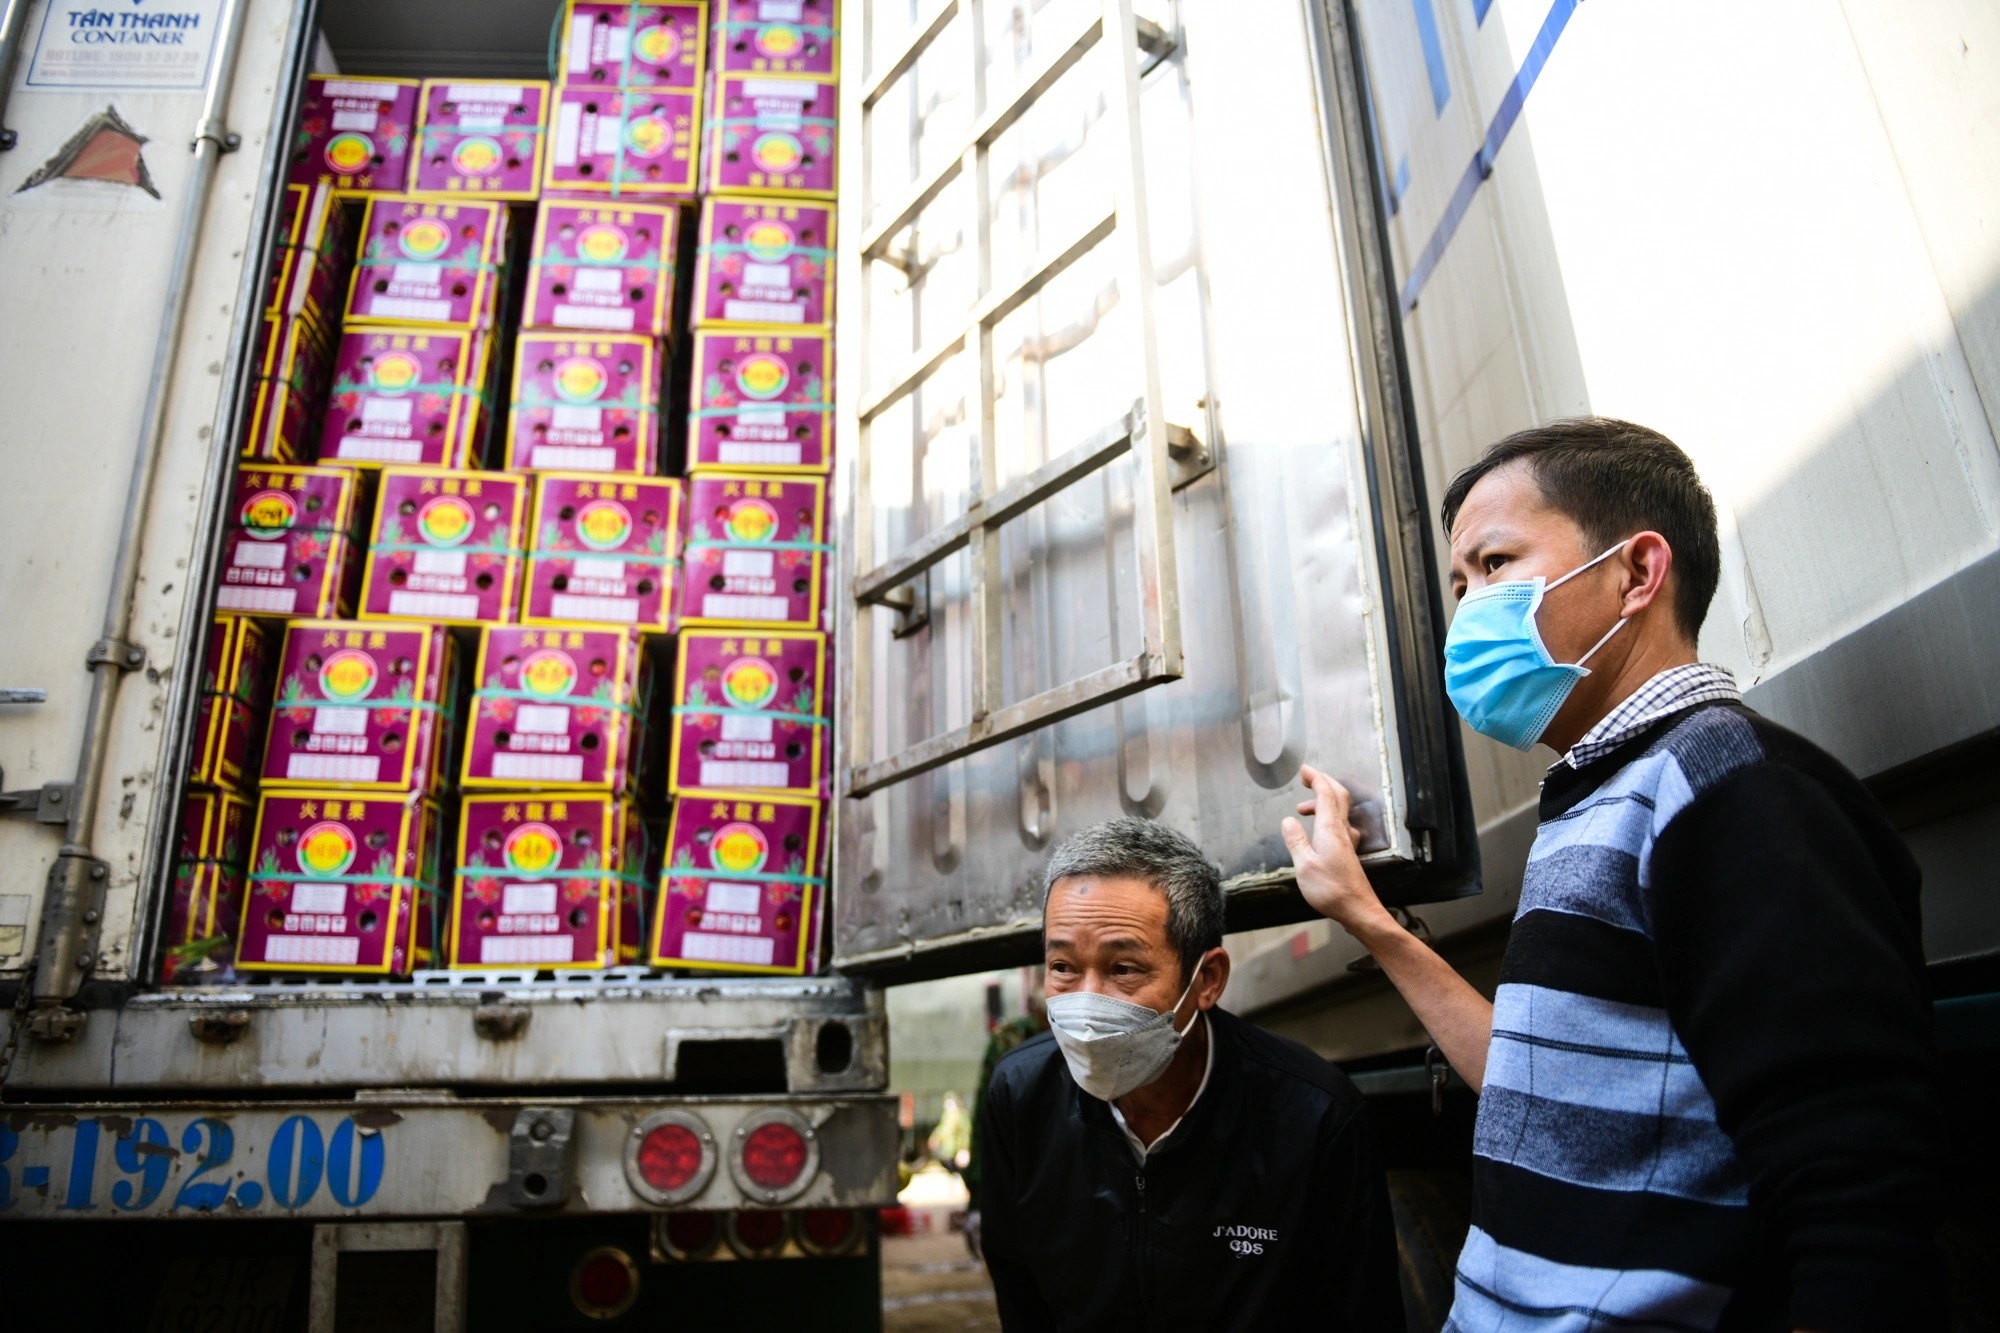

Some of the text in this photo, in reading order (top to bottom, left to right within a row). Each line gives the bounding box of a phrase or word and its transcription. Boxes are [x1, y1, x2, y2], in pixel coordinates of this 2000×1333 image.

[68, 9, 114, 28] TÂN
[71, 29, 185, 45] CONTAINER
[1213, 1225, 1278, 1240] J'ADORE
